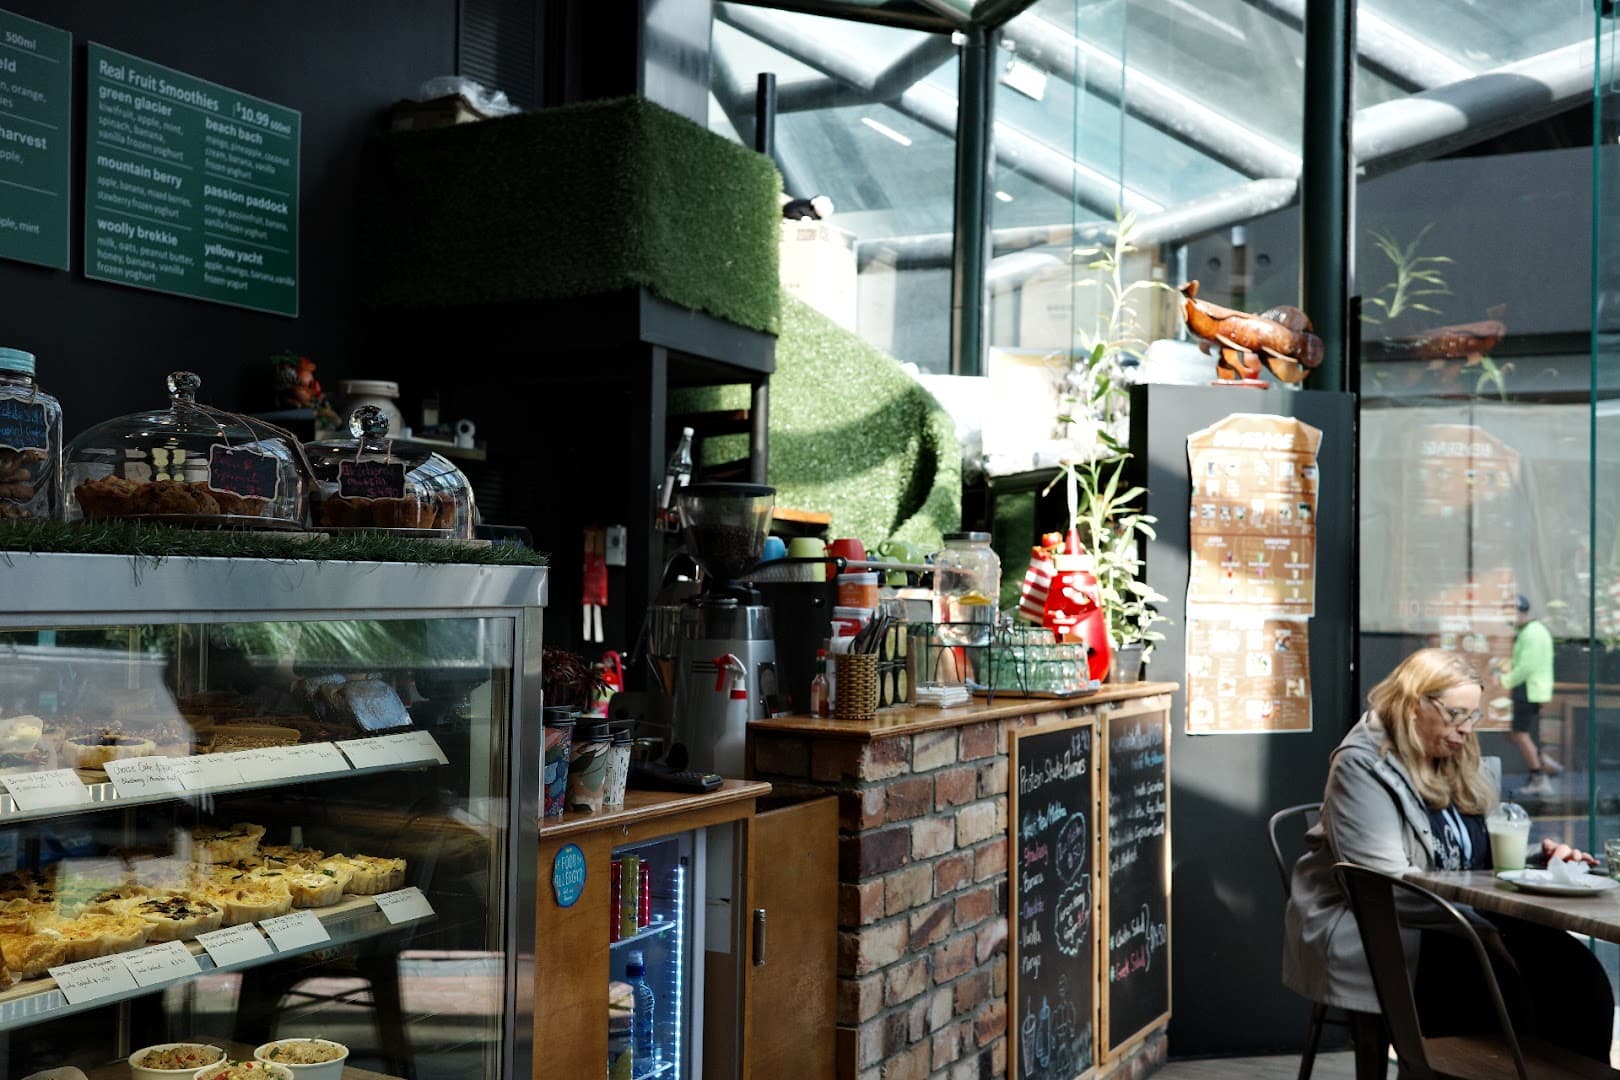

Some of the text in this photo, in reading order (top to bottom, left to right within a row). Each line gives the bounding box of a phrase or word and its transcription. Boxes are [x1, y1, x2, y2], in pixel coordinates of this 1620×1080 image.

[6, 32, 37, 50] 500ml
[11, 84, 48, 104] orange,
[99, 59, 125, 81] Real
[128, 69, 157, 91] Fruit
[159, 79, 219, 112] Smoothies
[98, 85, 173, 118] green glacier
[133, 125, 166, 145] banana,
[163, 122, 184, 137] mint,
[205, 116, 263, 145] beach bach
[98, 130, 125, 145] vanilla
[126, 136, 152, 152] frozen
[97, 155, 183, 189] mountain berry
[204, 184, 288, 215] passion paddock
[19, 221, 41, 235] mint
[97, 218, 178, 246] woolly brekkie
[140, 247, 168, 261] peanut
[204, 243, 263, 267] yellow yacht
[97, 261, 156, 283] frozen yoghurt
[158, 262, 184, 277] vanilla
[1019, 757, 1044, 796] Protein
[561, 853, 577, 871] FOOD
